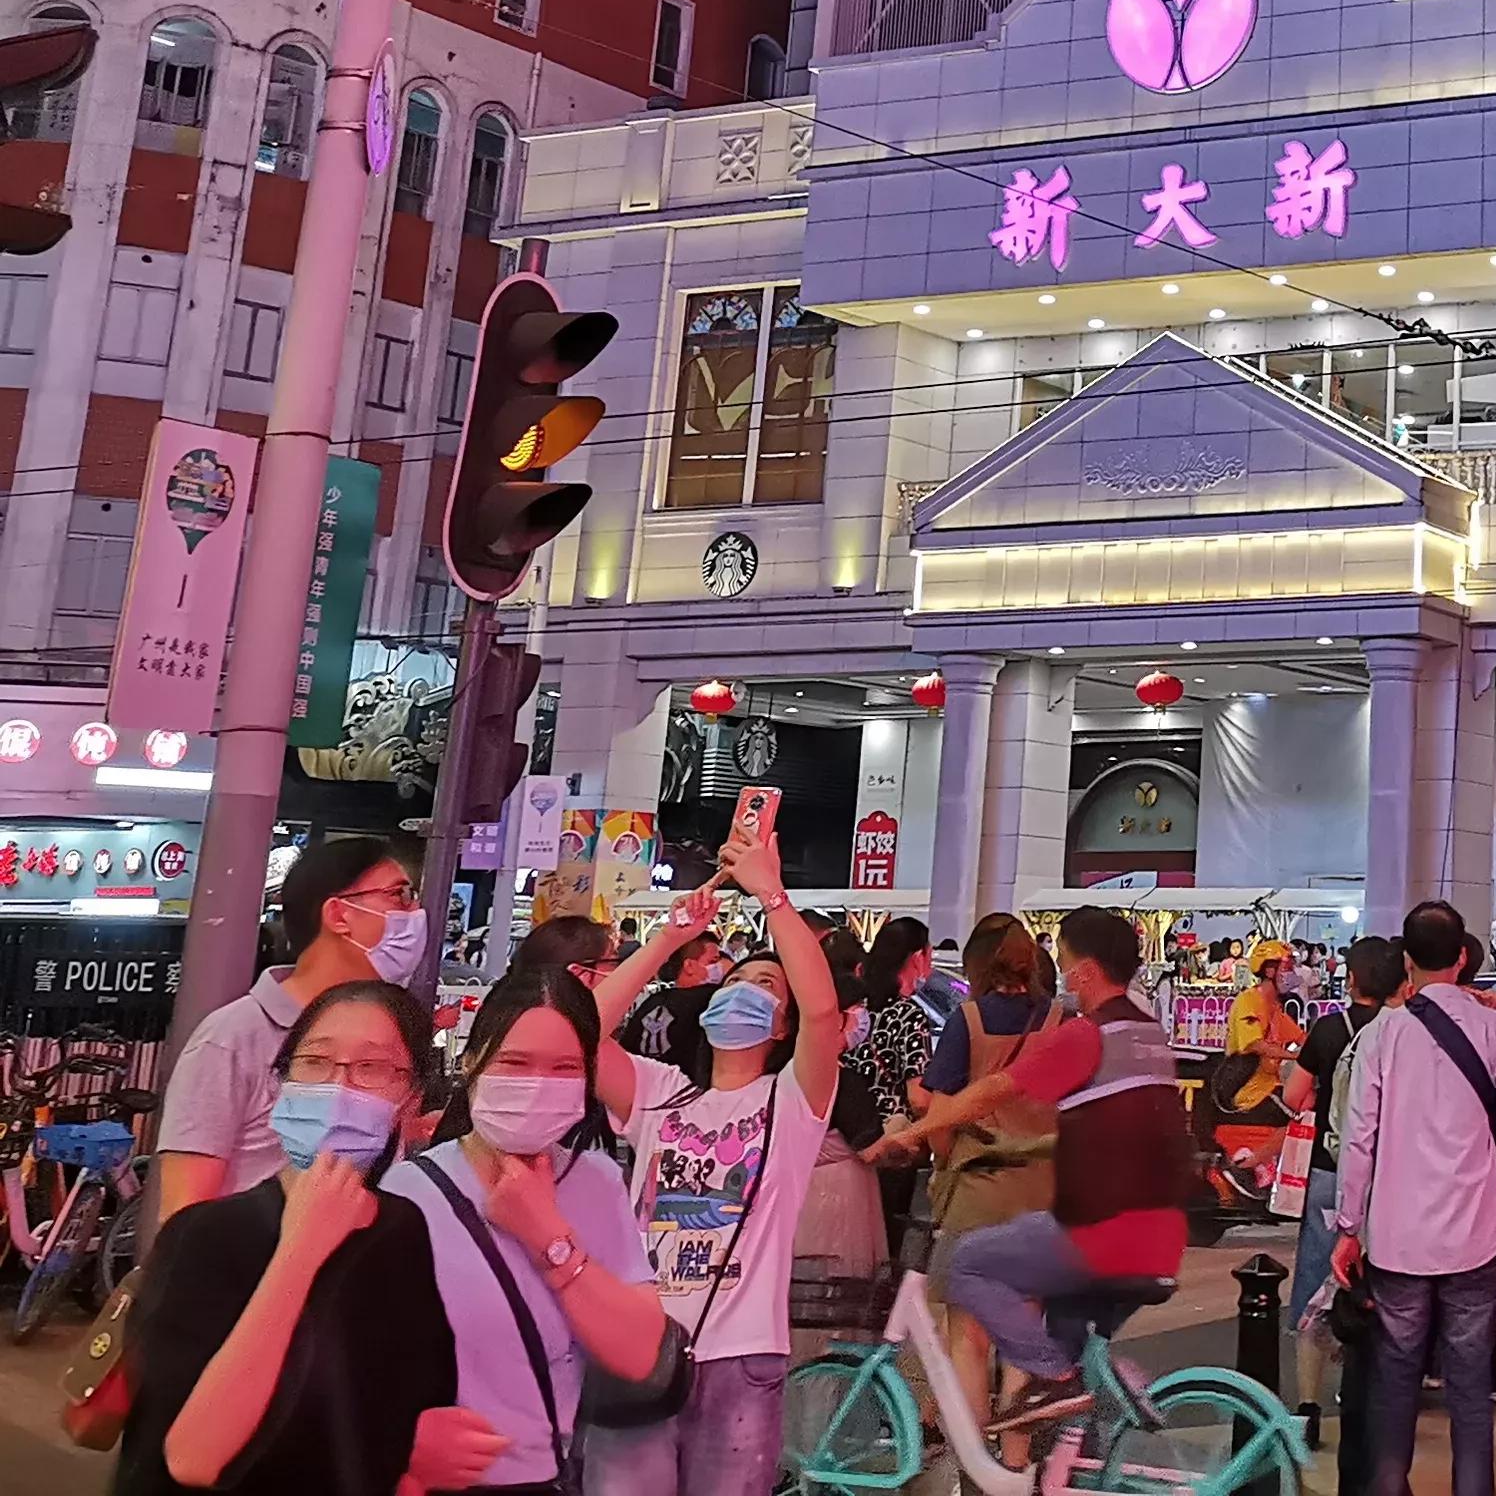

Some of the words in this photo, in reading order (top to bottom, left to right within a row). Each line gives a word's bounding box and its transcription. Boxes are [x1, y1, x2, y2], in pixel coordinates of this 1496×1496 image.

[989, 138, 1356, 272] 新大新
[857, 830, 895, 856] 虾饺
[857, 859, 889, 887] 1元
[34, 960, 58, 992] 警
[64, 961, 157, 992] POLICE
[677, 1253, 710, 1265] THE
